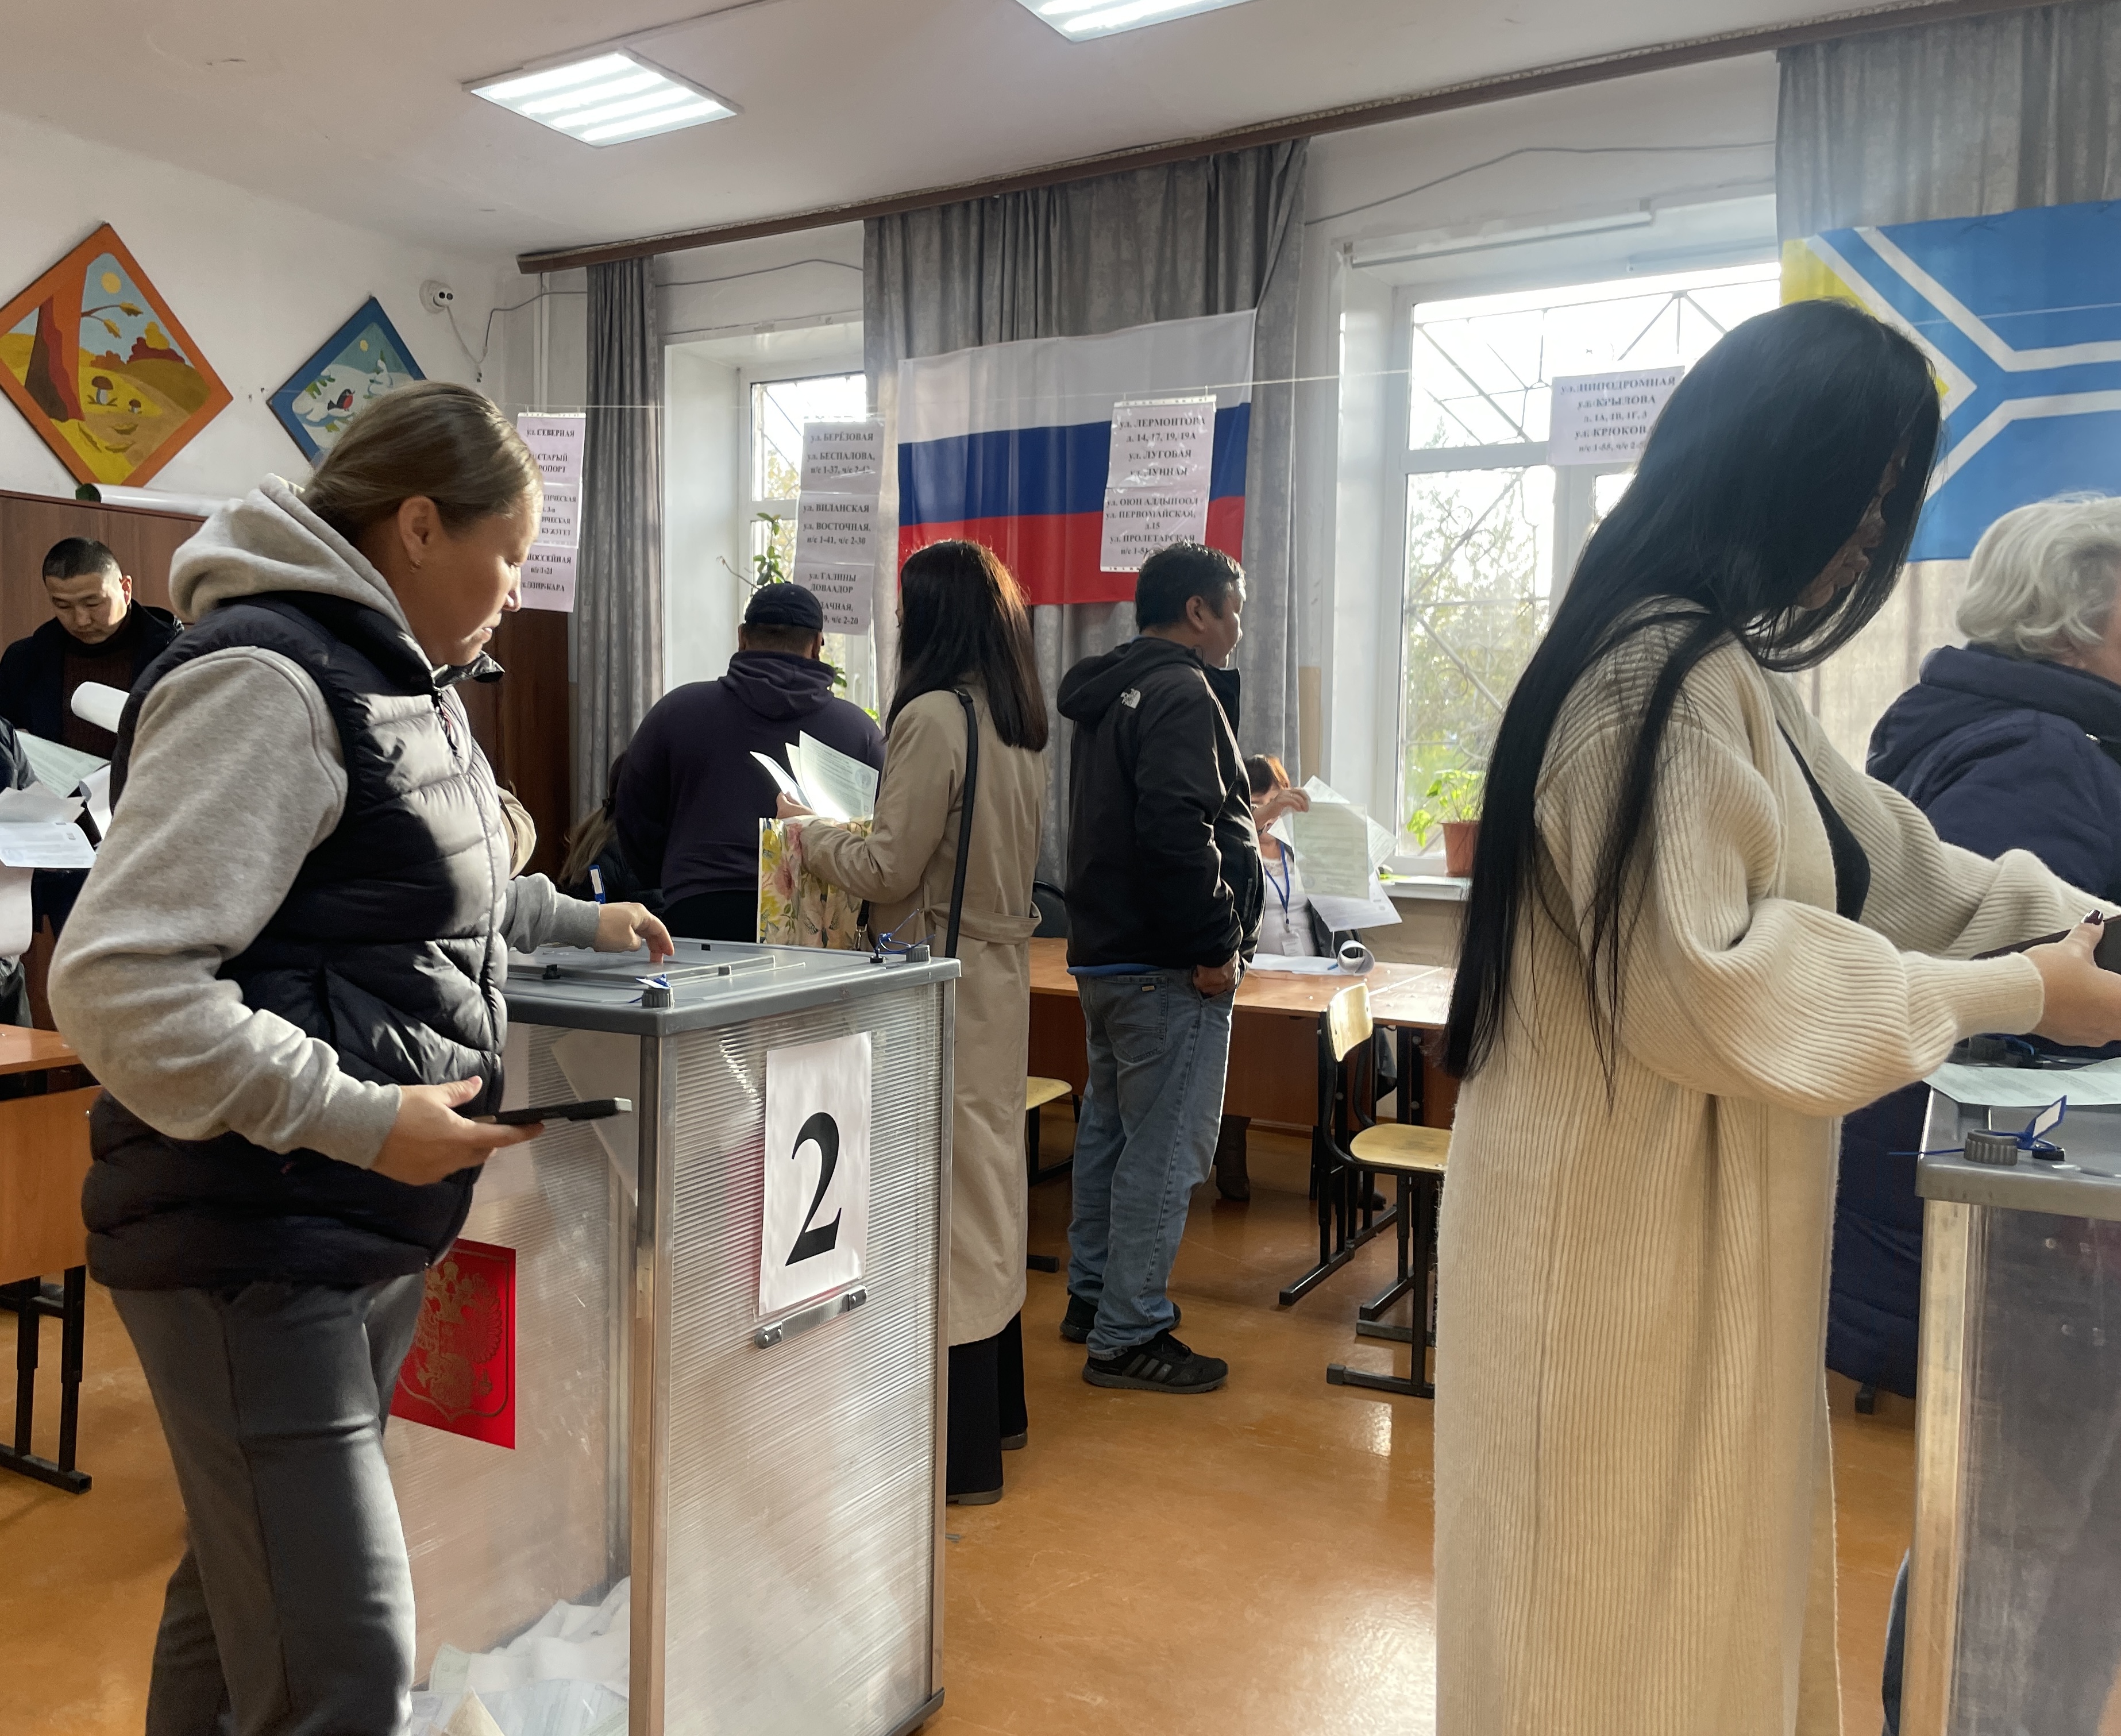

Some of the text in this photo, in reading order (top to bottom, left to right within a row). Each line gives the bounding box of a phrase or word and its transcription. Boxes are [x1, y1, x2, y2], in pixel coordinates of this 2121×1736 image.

[1596, 395, 1656, 407] КРЫЛОВА
[1135, 417, 1205, 428] ЛЕРМОНТОВА
[537, 429, 574, 438] СЕВЕРНАЯ
[824, 431, 874, 441] БЕРЁЗОВАЯ
[1181, 432, 1196, 440] 19А
[1593, 425, 1646, 437] КРЮКОВ
[537, 453, 568, 462] СТАРЫЙ
[820, 452, 876, 461] БЕСПАЛОВА,
[1143, 450, 1191, 460] ЛУГОВАЯ
[1120, 498, 1142, 506] ОЮН
[803, 506, 814, 514] ул.
[1119, 510, 1196, 518] ПЕРВОМАЙСКАЯ,
[803, 522, 871, 532] ул. ВОСТОЧНАЯ,
[820, 572, 857, 582] ГАЛИНЫ
[785, 1112, 842, 1267] 2
